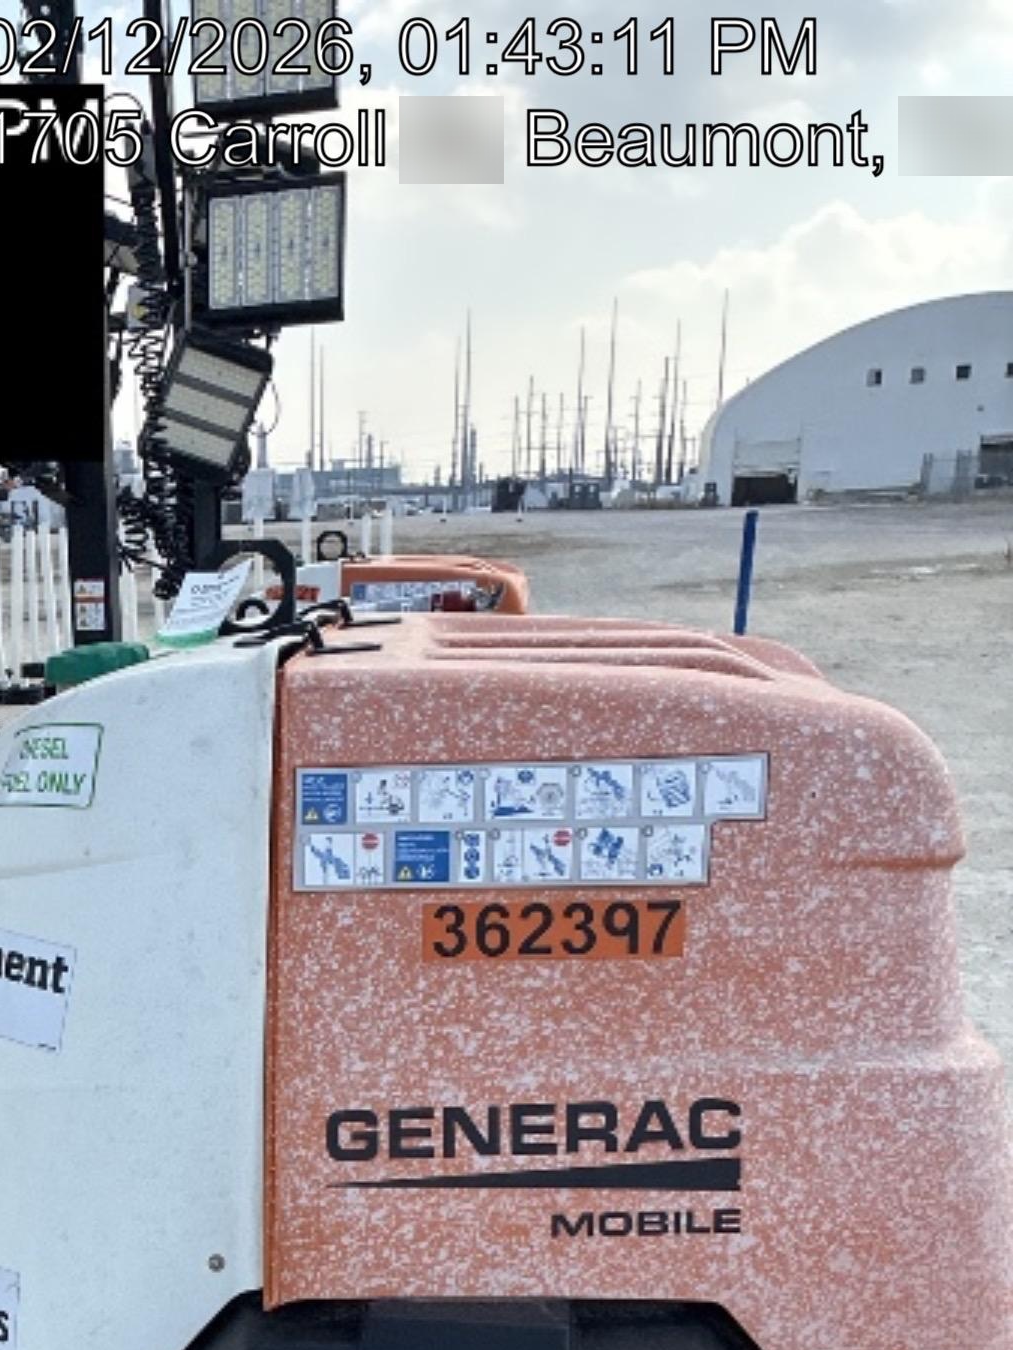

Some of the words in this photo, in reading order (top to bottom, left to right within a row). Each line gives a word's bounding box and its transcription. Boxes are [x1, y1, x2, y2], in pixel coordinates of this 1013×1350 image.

[37, 770, 87, 795] ONLY
[433, 900, 682, 957] 362397
[325, 1098, 742, 1162] GENERAC
[550, 1208, 742, 1238] MOBILE
